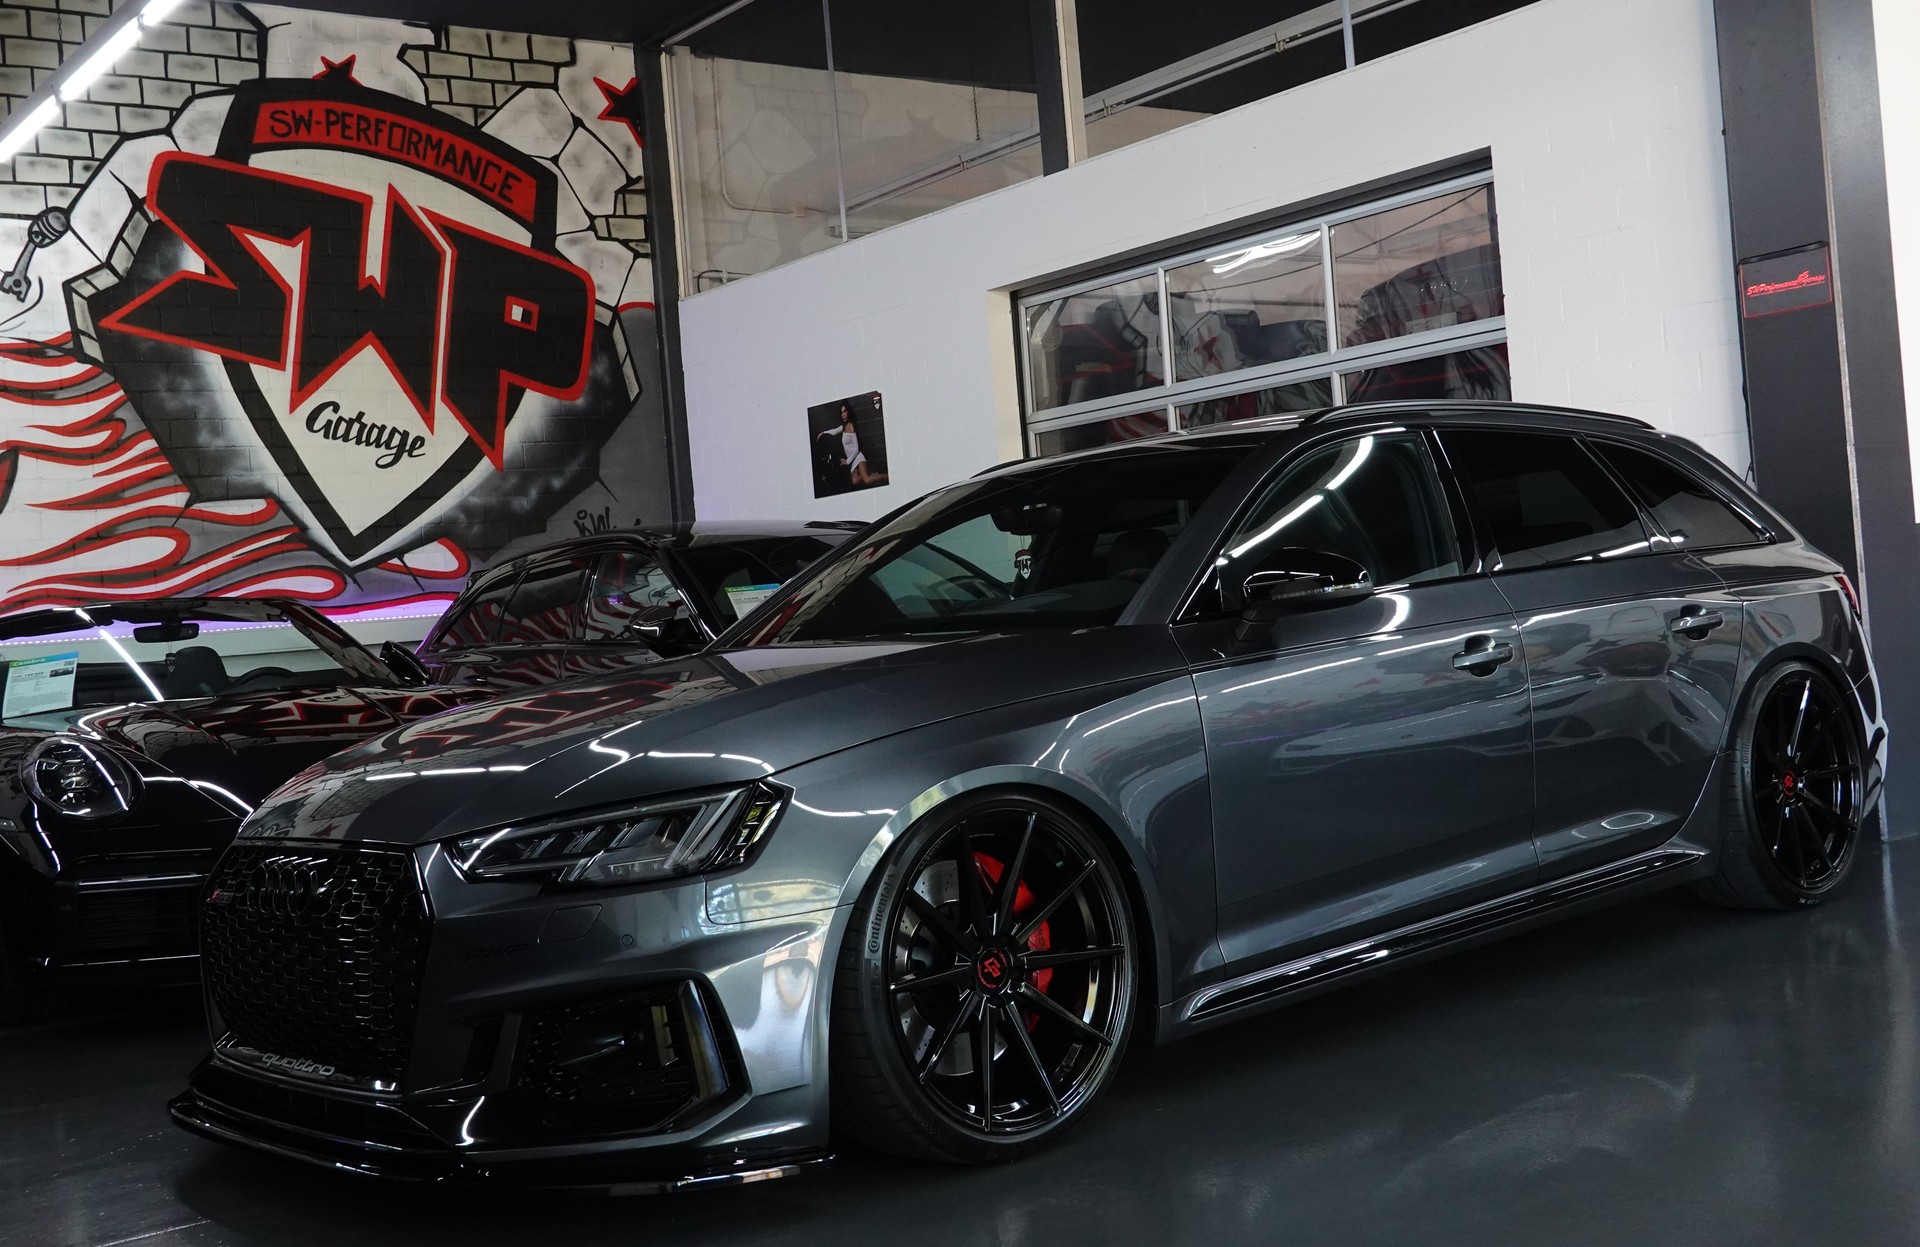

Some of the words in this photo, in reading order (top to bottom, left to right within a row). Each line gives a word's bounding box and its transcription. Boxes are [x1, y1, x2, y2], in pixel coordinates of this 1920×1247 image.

[268, 107, 522, 204] SW-PERFORMANCE
[99, 150, 596, 472] SWP
[305, 400, 426, 469] Garage
[867, 880, 894, 954] Continental
[261, 1052, 336, 1077] quattro
